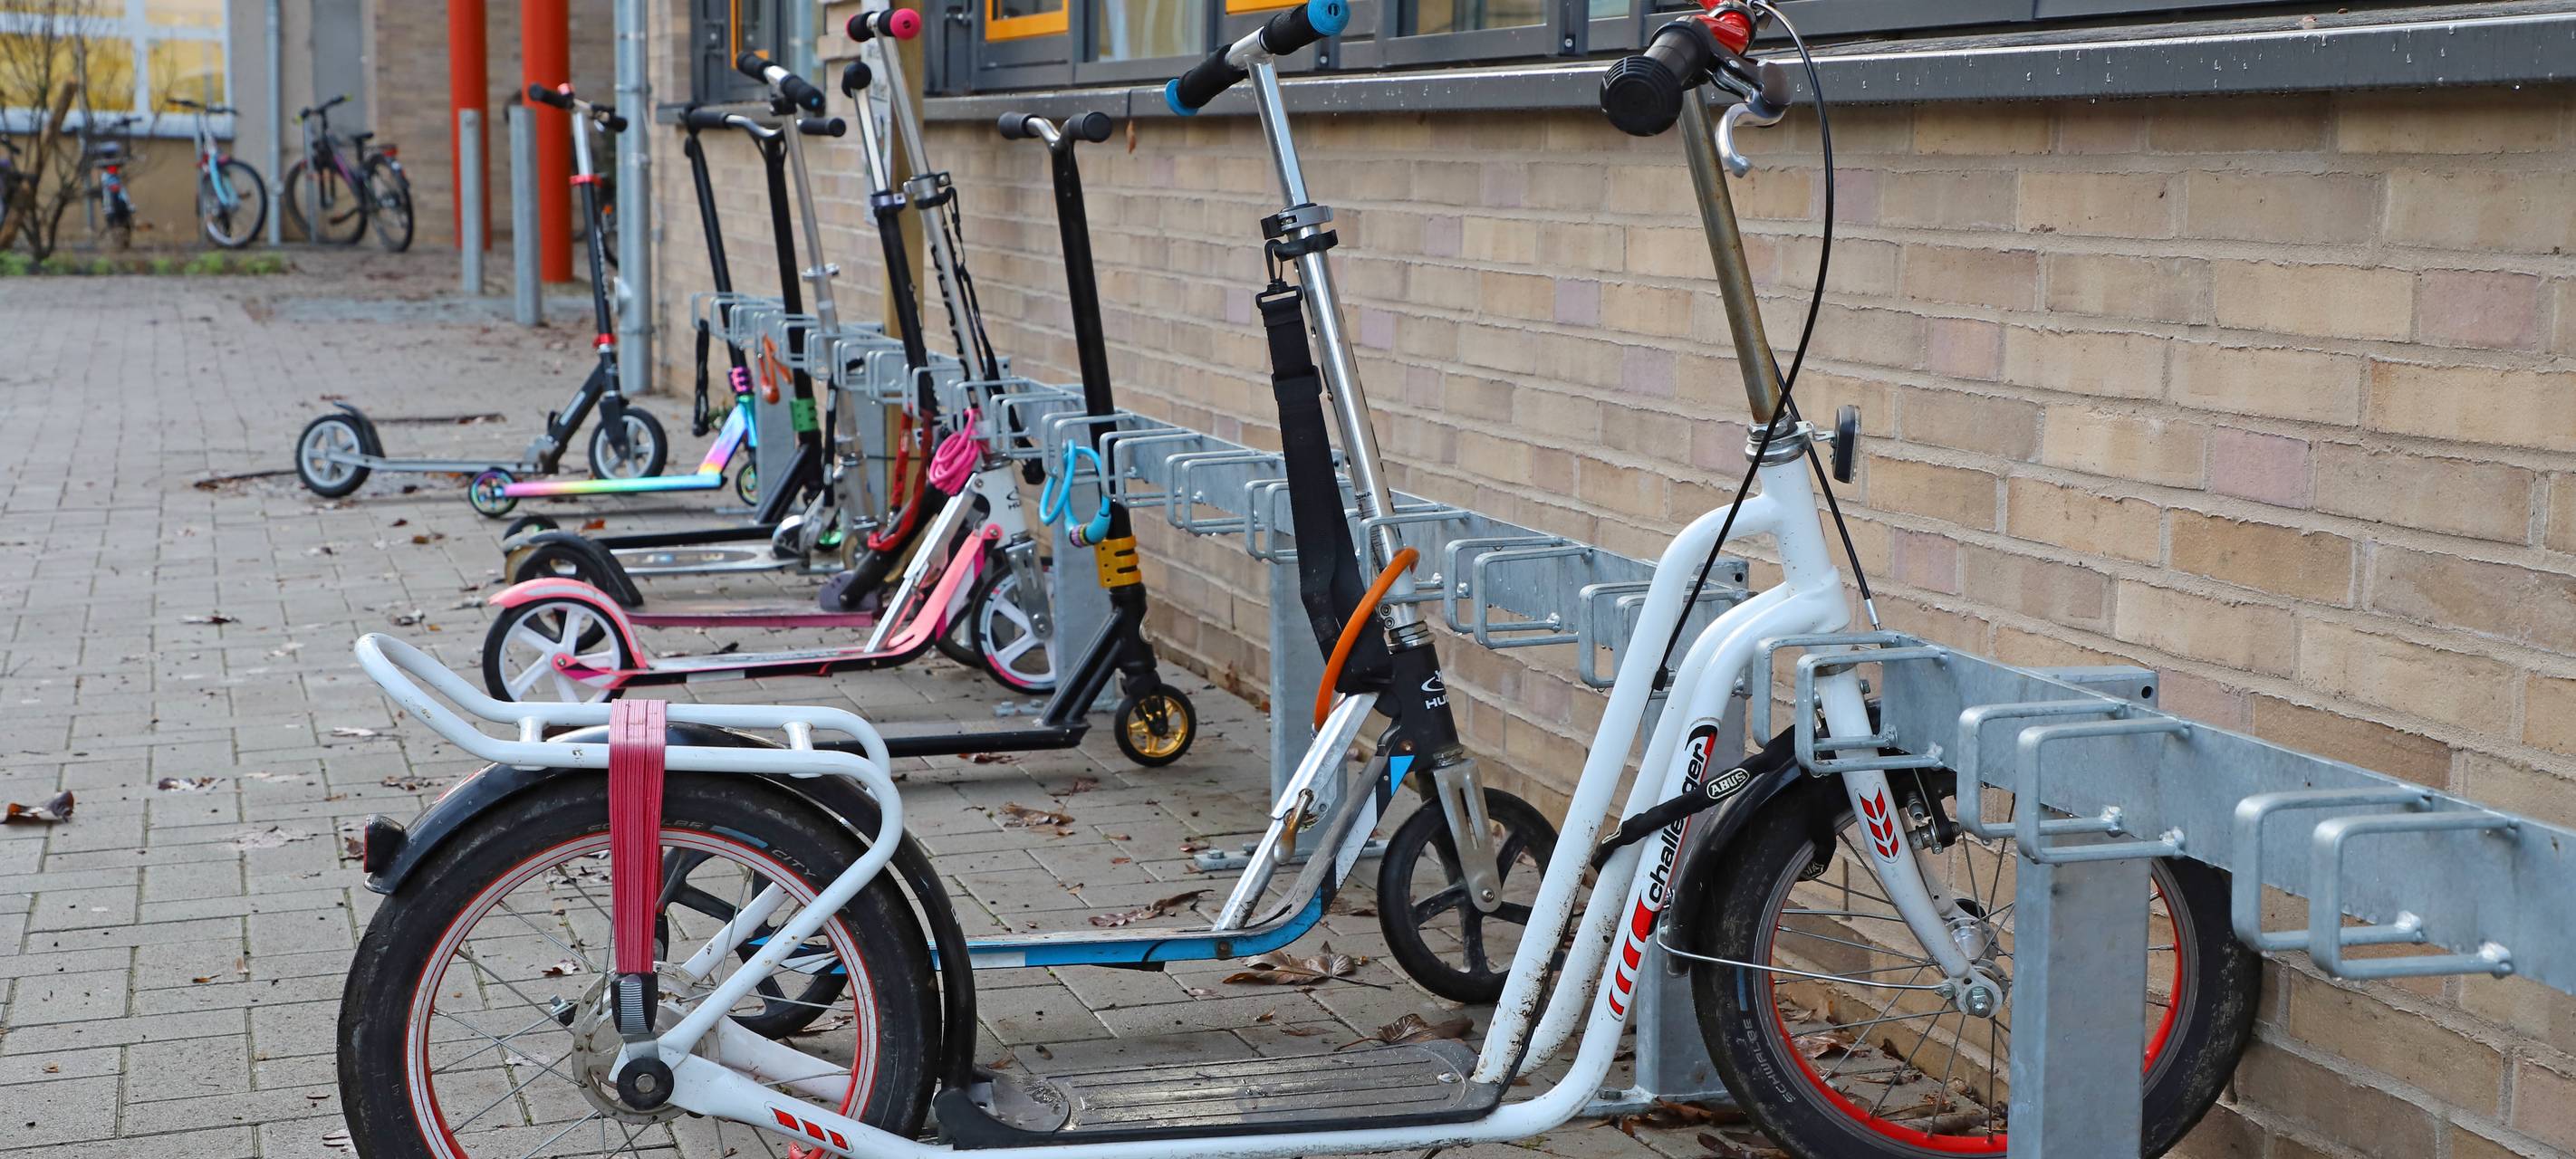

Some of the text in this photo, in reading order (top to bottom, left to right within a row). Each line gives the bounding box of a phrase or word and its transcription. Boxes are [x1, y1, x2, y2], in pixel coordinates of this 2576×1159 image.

[1710, 771, 1746, 796] ABUS
[1648, 742, 1706, 904] challeger
[770, 848, 818, 877] CITY
[1743, 1018, 1797, 1104] SCHWALBE
